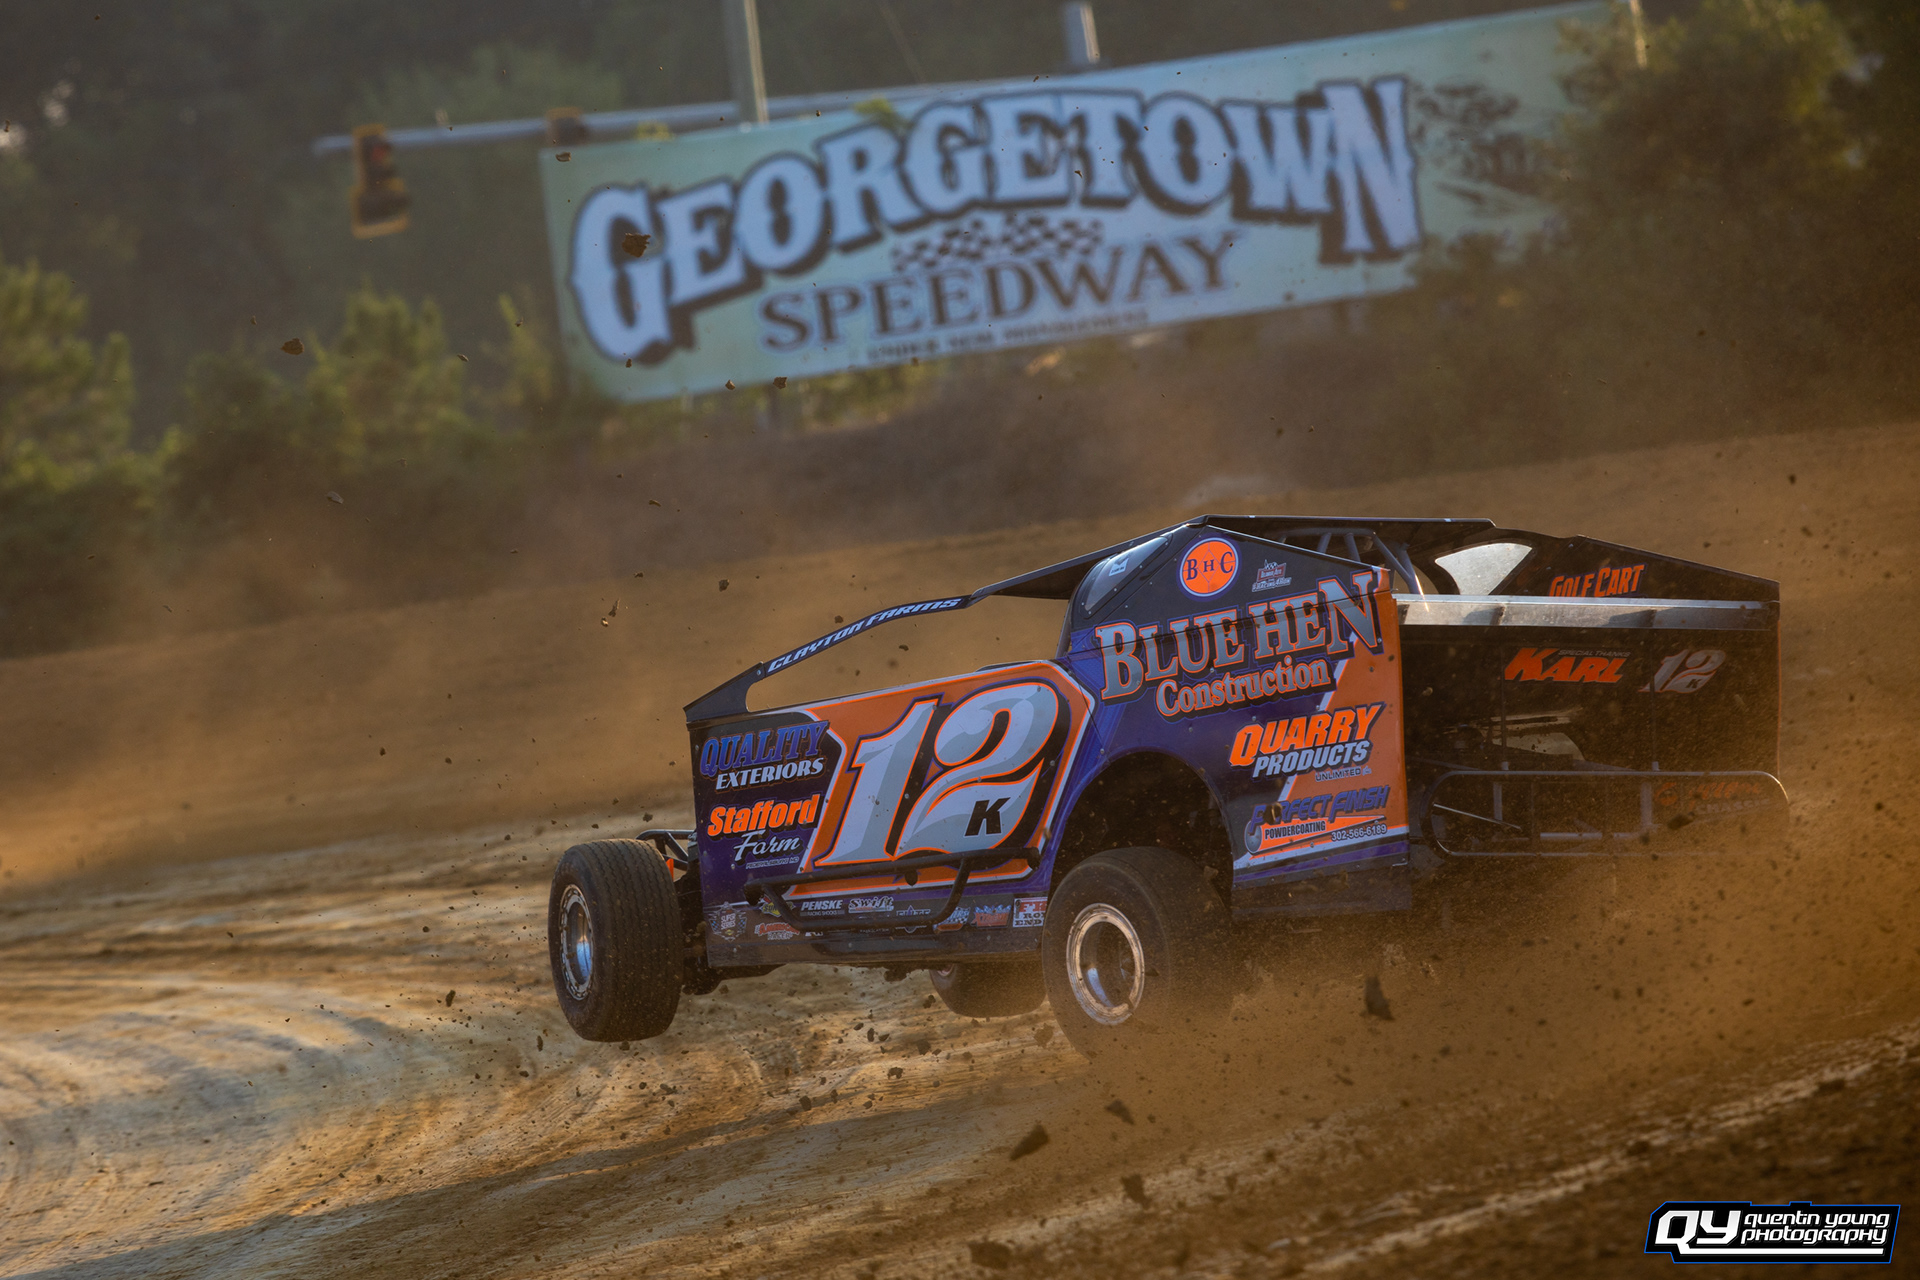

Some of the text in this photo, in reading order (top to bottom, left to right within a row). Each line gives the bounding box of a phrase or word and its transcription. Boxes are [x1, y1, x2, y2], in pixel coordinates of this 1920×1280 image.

[569, 76, 1422, 364] GEORGETOWN
[760, 231, 1240, 351] SPEEDWAY
[1594, 565, 1645, 598] CART
[768, 598, 962, 673] CLAYTON FARMS
[1095, 571, 1380, 699] BLUE HEN
[1156, 655, 1331, 717] Construction
[1504, 647, 1628, 684] KARL
[1637, 650, 1727, 693] 12
[700, 721, 829, 775] QUALITY
[1229, 702, 1385, 767] QUARRY
[716, 757, 824, 790] EXTERIORS
[814, 682, 1060, 867] 12 K
[1252, 740, 1371, 778] PRODUCTS
[1315, 767, 1362, 782] UNLIMITED
[707, 793, 821, 837] Stafford
[1248, 785, 1390, 834] PRFECT FINISH
[1264, 820, 1327, 840] POWDERCOATING
[733, 829, 800, 862] Farm
[1331, 823, 1388, 842] 302-566-6189
[801, 900, 843, 911] PENSKE
